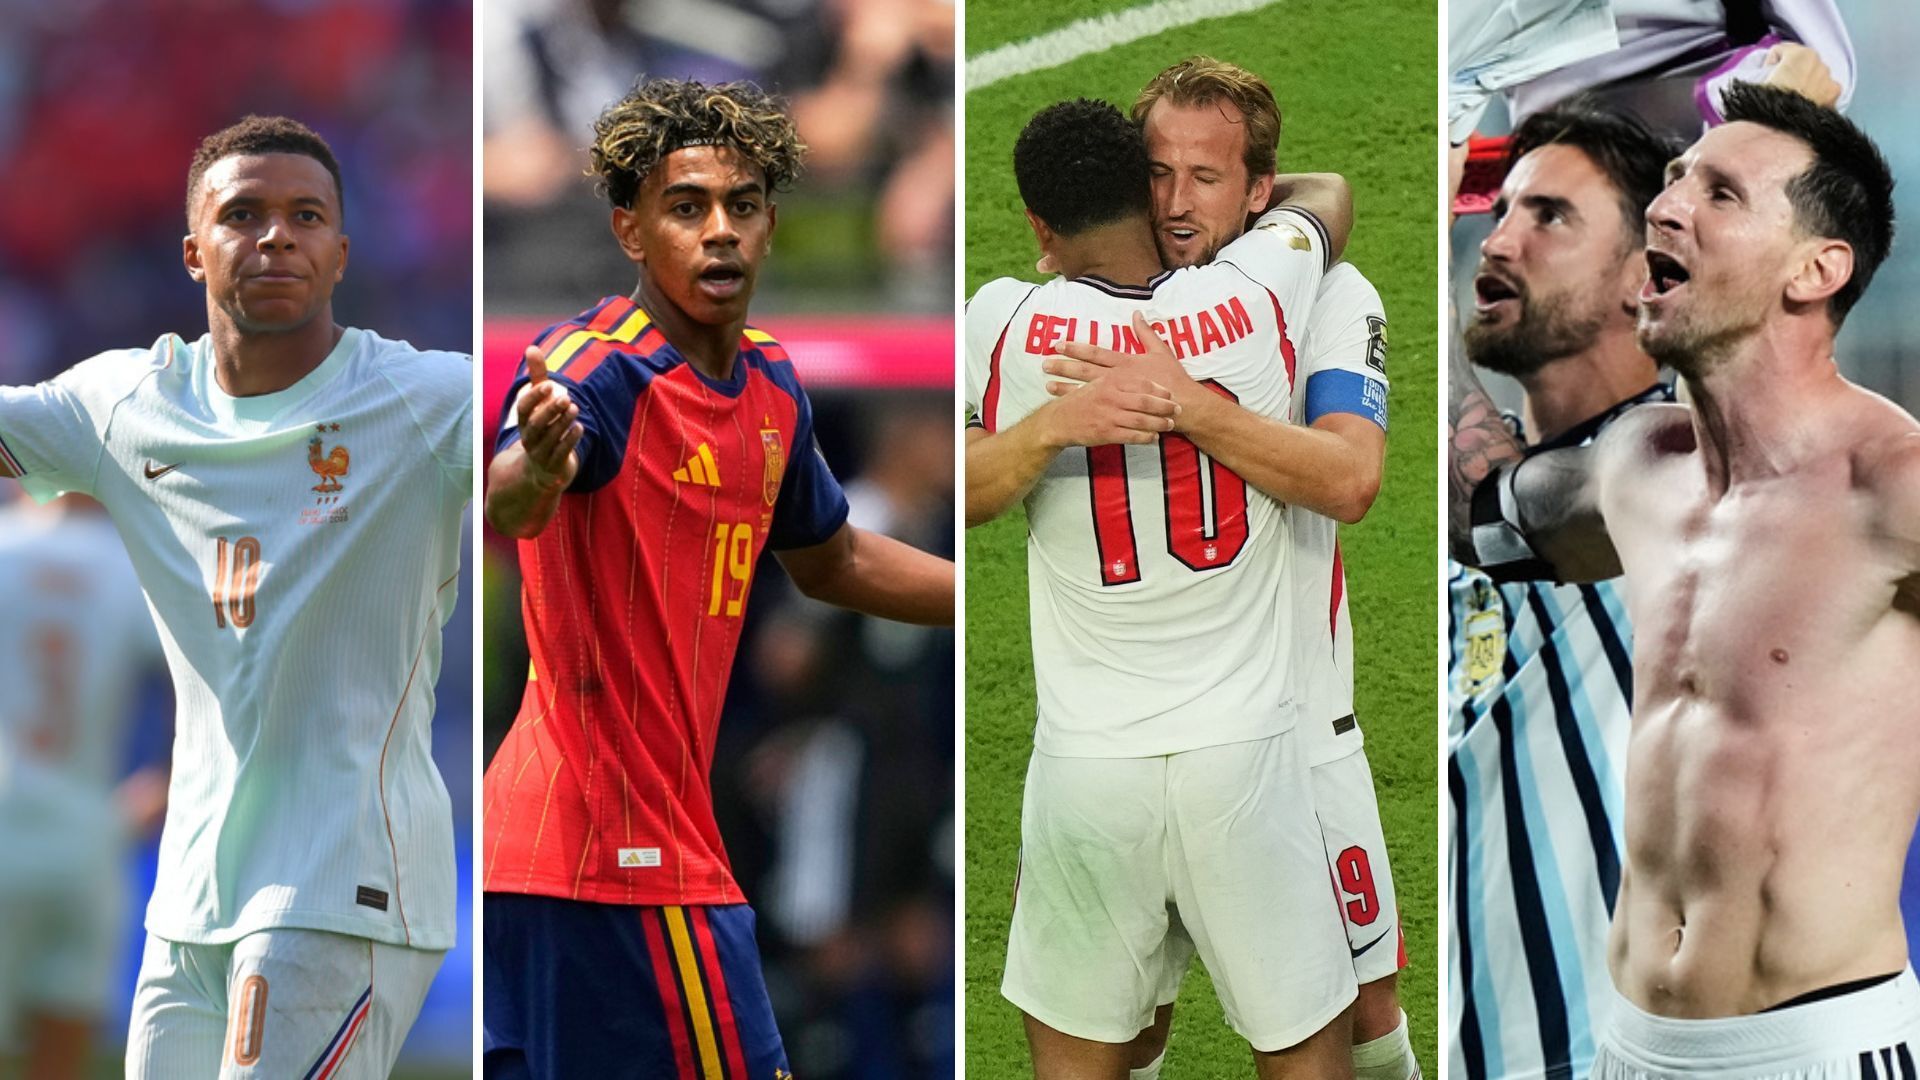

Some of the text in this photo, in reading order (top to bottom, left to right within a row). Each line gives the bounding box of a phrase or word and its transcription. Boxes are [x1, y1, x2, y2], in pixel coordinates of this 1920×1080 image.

[1086, 378, 1249, 587] 10
[213, 536, 261, 629] 10
[708, 523, 752, 616] 19
[1335, 845, 1380, 927] 9
